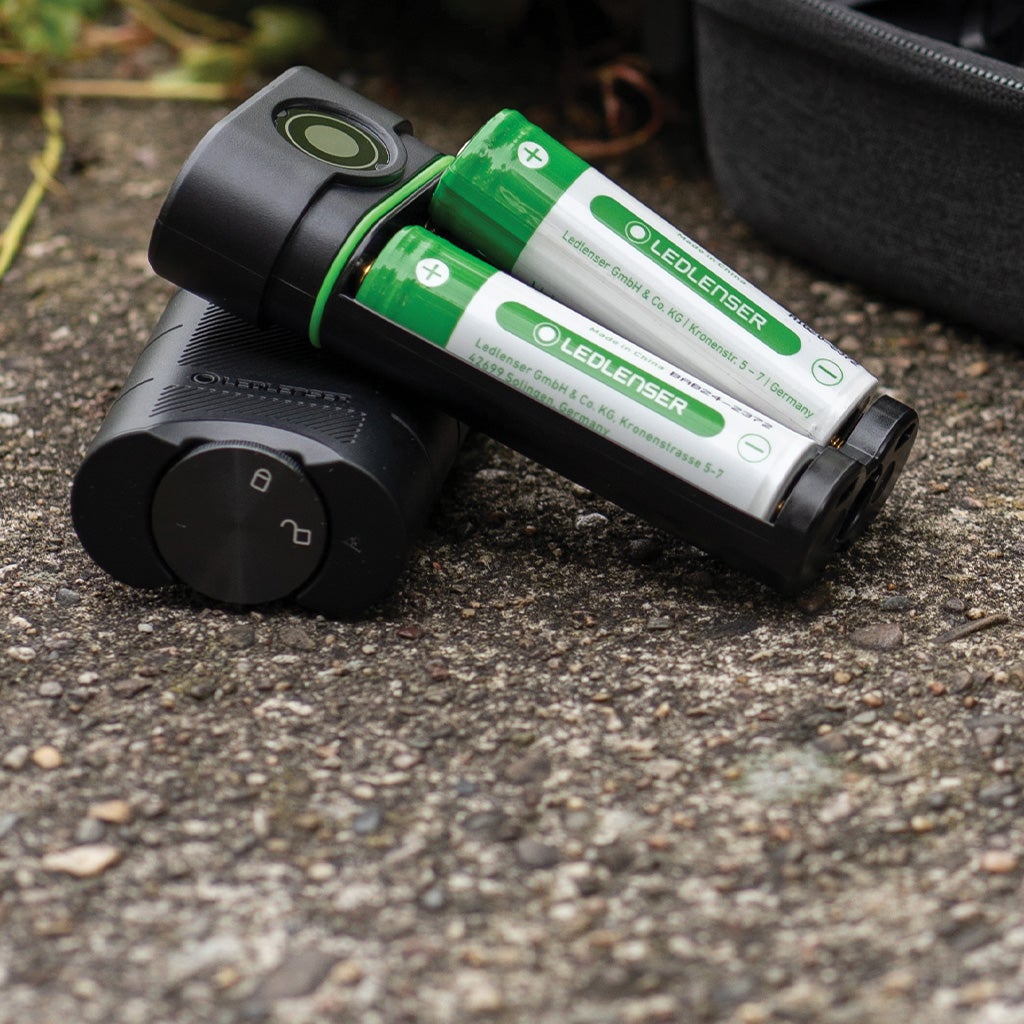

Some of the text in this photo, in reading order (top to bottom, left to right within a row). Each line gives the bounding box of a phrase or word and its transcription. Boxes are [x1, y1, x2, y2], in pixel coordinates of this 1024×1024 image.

[561, 229, 611, 269] Ledlenser
[610, 266, 643, 293] GmbH
[641, 289, 651, 300] &
[651, 296, 665, 313] Co.
[667, 307, 684, 323] KG
[688, 321, 737, 365] Kronenstr.
[738, 359, 749, 370] 5
[756, 372, 765, 382] 7
[769, 381, 815, 419] Germany
[650, 239, 768, 331] LEDLENSER
[560, 337, 689, 416] LEDLENSER
[589, 326, 620, 346] Made
[633, 349, 666, 371] China
[468, 352, 505, 377] 42699
[558, 402, 611, 437] Germany
[474, 337, 533, 374] Ledlenser
[533, 369, 569, 394] GmbH
[568, 388, 578, 400] &
[579, 394, 595, 411] Co.
[597, 404, 616, 424] KG,
[619, 416, 702, 470] Kronenstrasse
